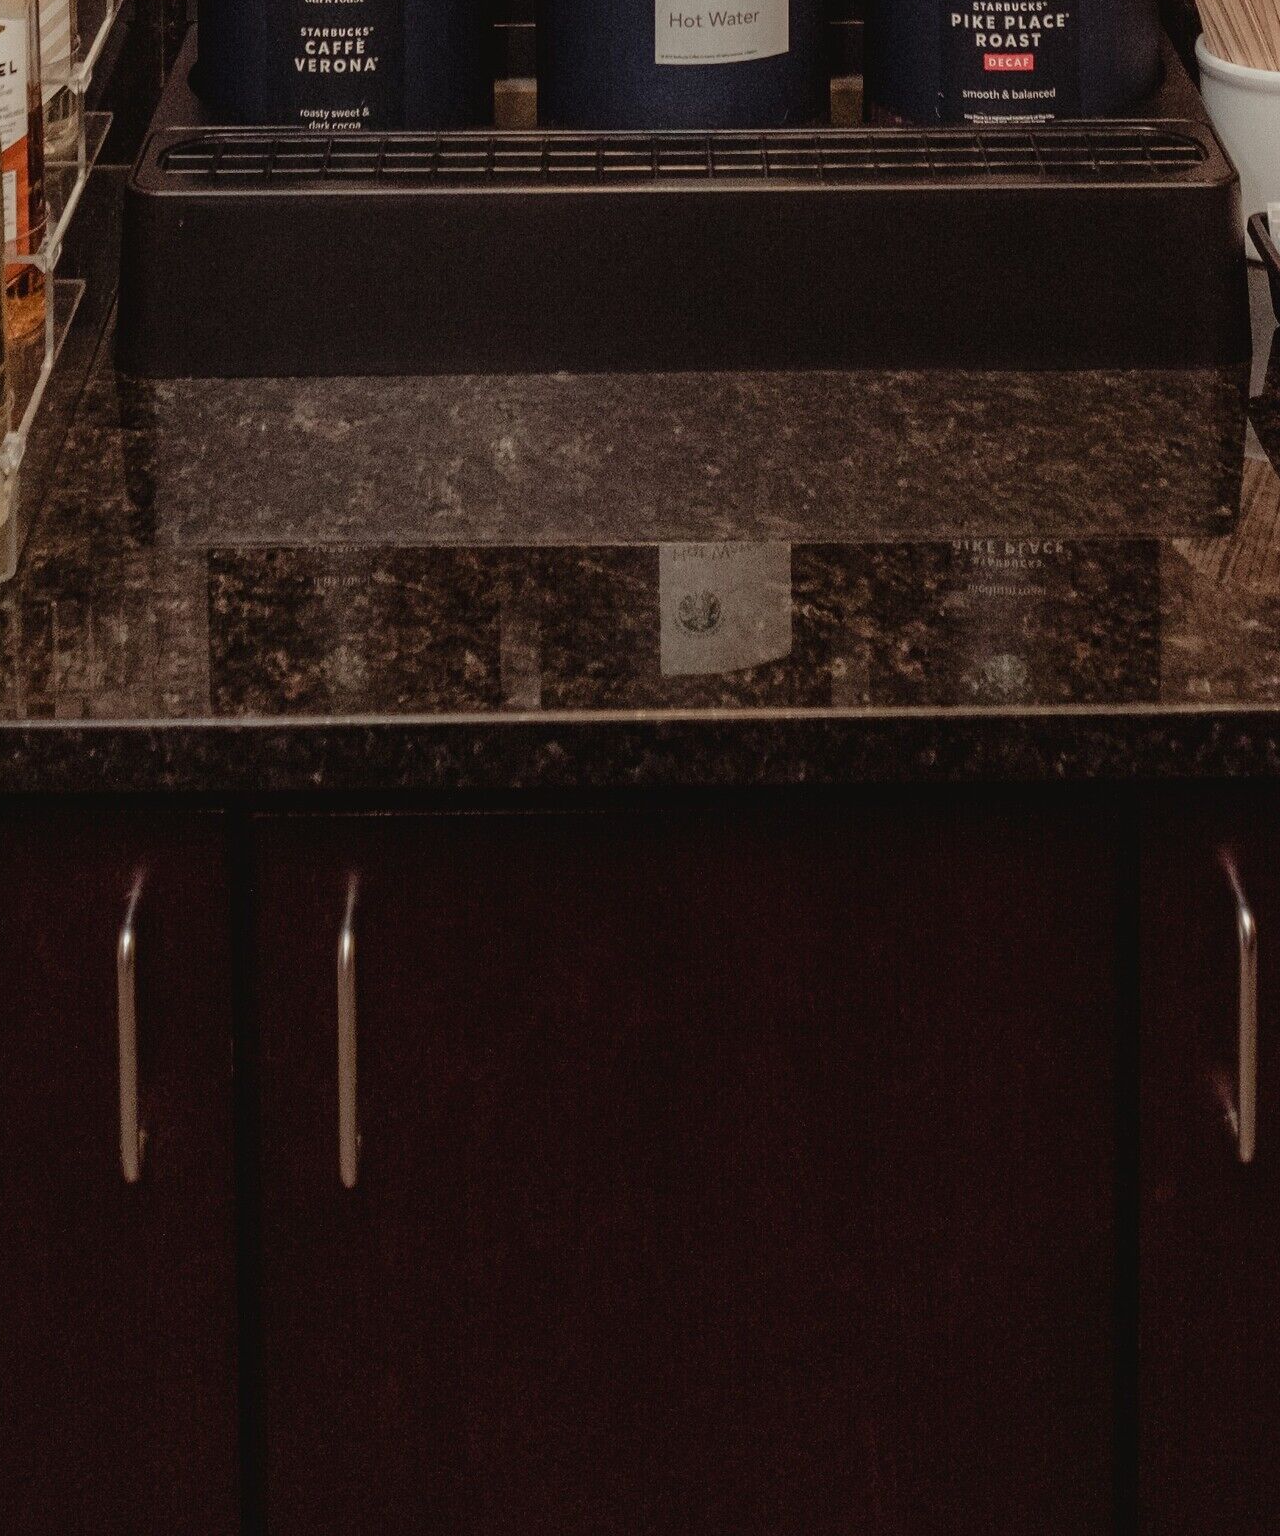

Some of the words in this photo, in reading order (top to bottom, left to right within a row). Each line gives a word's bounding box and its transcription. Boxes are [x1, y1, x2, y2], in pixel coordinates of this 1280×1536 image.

[670, 13, 703, 28] Hot
[708, 10, 760, 27] Water
[951, 13, 995, 29] PIKE
[305, 38, 366, 55] CAFFÈ
[975, 33, 1042, 48] ROAST
[988, 58, 1030, 67] DECAF
[962, 89, 1000, 100] smooth
[1001, 89, 1009, 99] &
[1012, 88, 1056, 100] balanced
[300, 109, 329, 120] roasty
[331, 108, 360, 117] sweet
[362, 106, 370, 117] &
[308, 120, 330, 130] dark
[332, 121, 361, 130] cocoa
